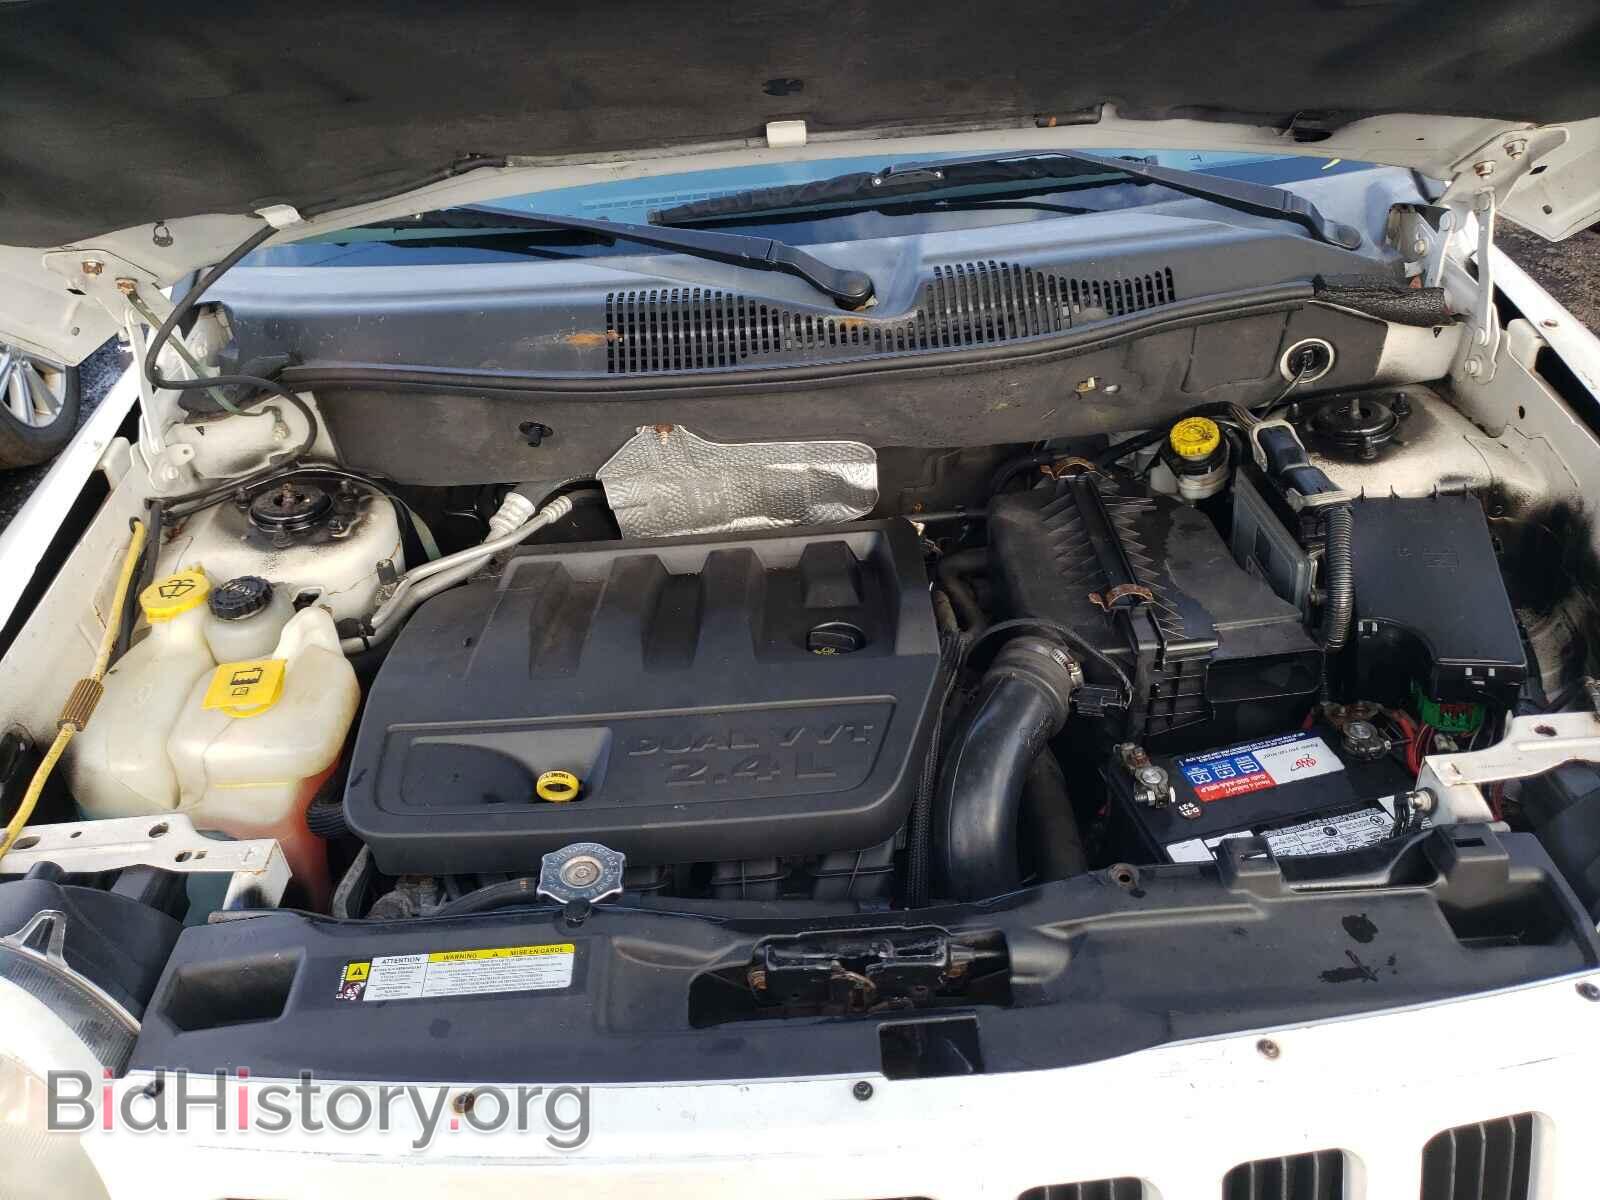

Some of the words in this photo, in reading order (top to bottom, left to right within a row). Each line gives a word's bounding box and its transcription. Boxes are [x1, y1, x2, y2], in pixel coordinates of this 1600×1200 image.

[628, 731, 761, 756] DUAL
[775, 724, 875, 747] VVT
[664, 753, 838, 786] 2.4L
[382, 955, 421, 965] ATTENTION
[443, 953, 477, 961] WARNING
[540, 946, 564, 954] GARDE
